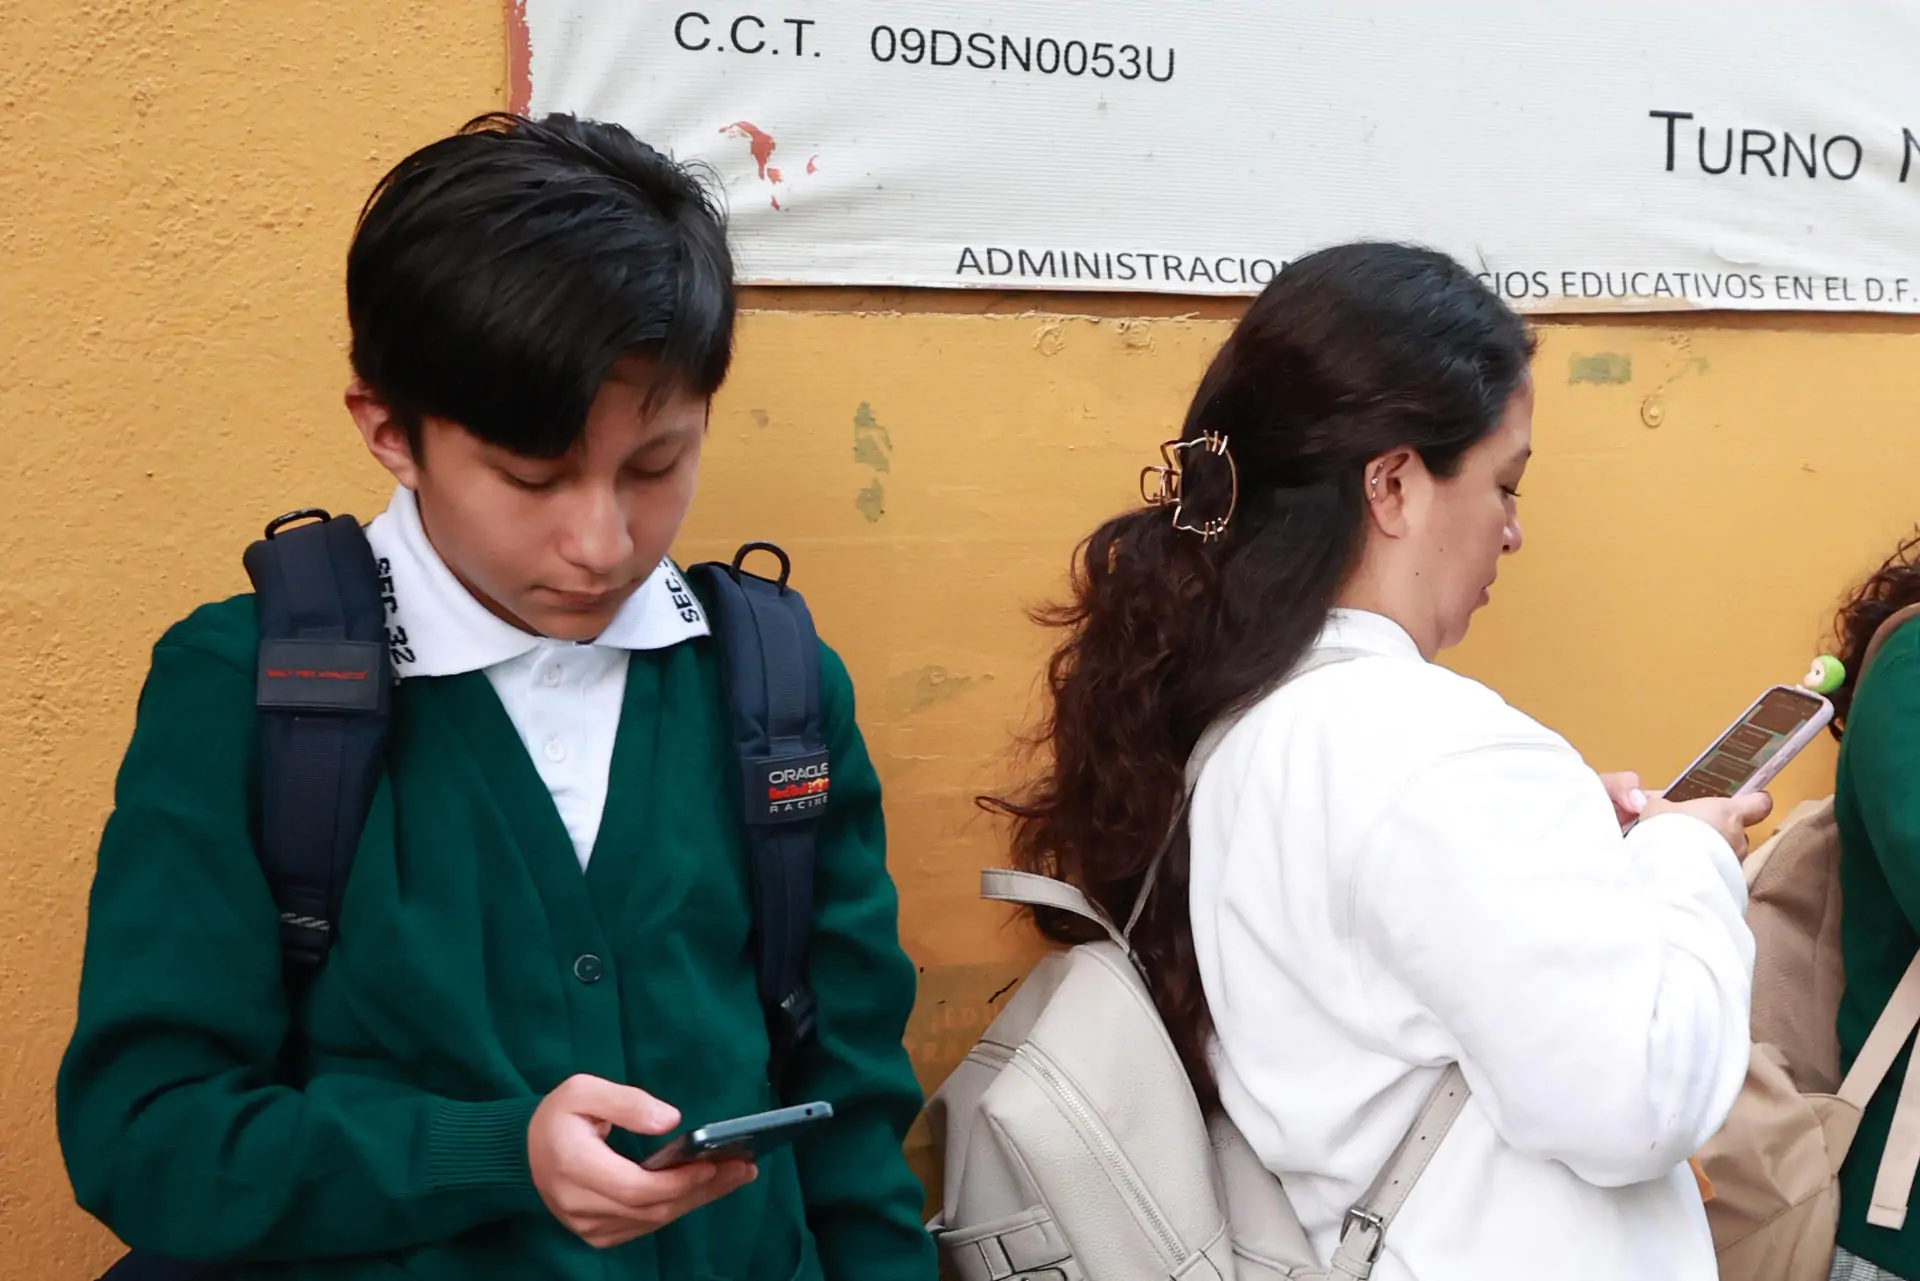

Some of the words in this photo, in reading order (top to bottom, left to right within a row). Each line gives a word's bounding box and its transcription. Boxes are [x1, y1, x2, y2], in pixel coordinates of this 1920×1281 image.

[674, 11, 821, 58] C.C.T.
[870, 25, 1175, 83] 09DSN0053U
[956, 247, 1288, 285] ADMINISTRACIO
[1561, 271, 1764, 299] EDUCATIVOS
[1775, 275, 1813, 300] EN
[1825, 276, 1857, 301] EL
[1865, 277, 1918, 303] D.F.
[386, 626, 416, 664] 32
[768, 762, 829, 784] ORACLE
